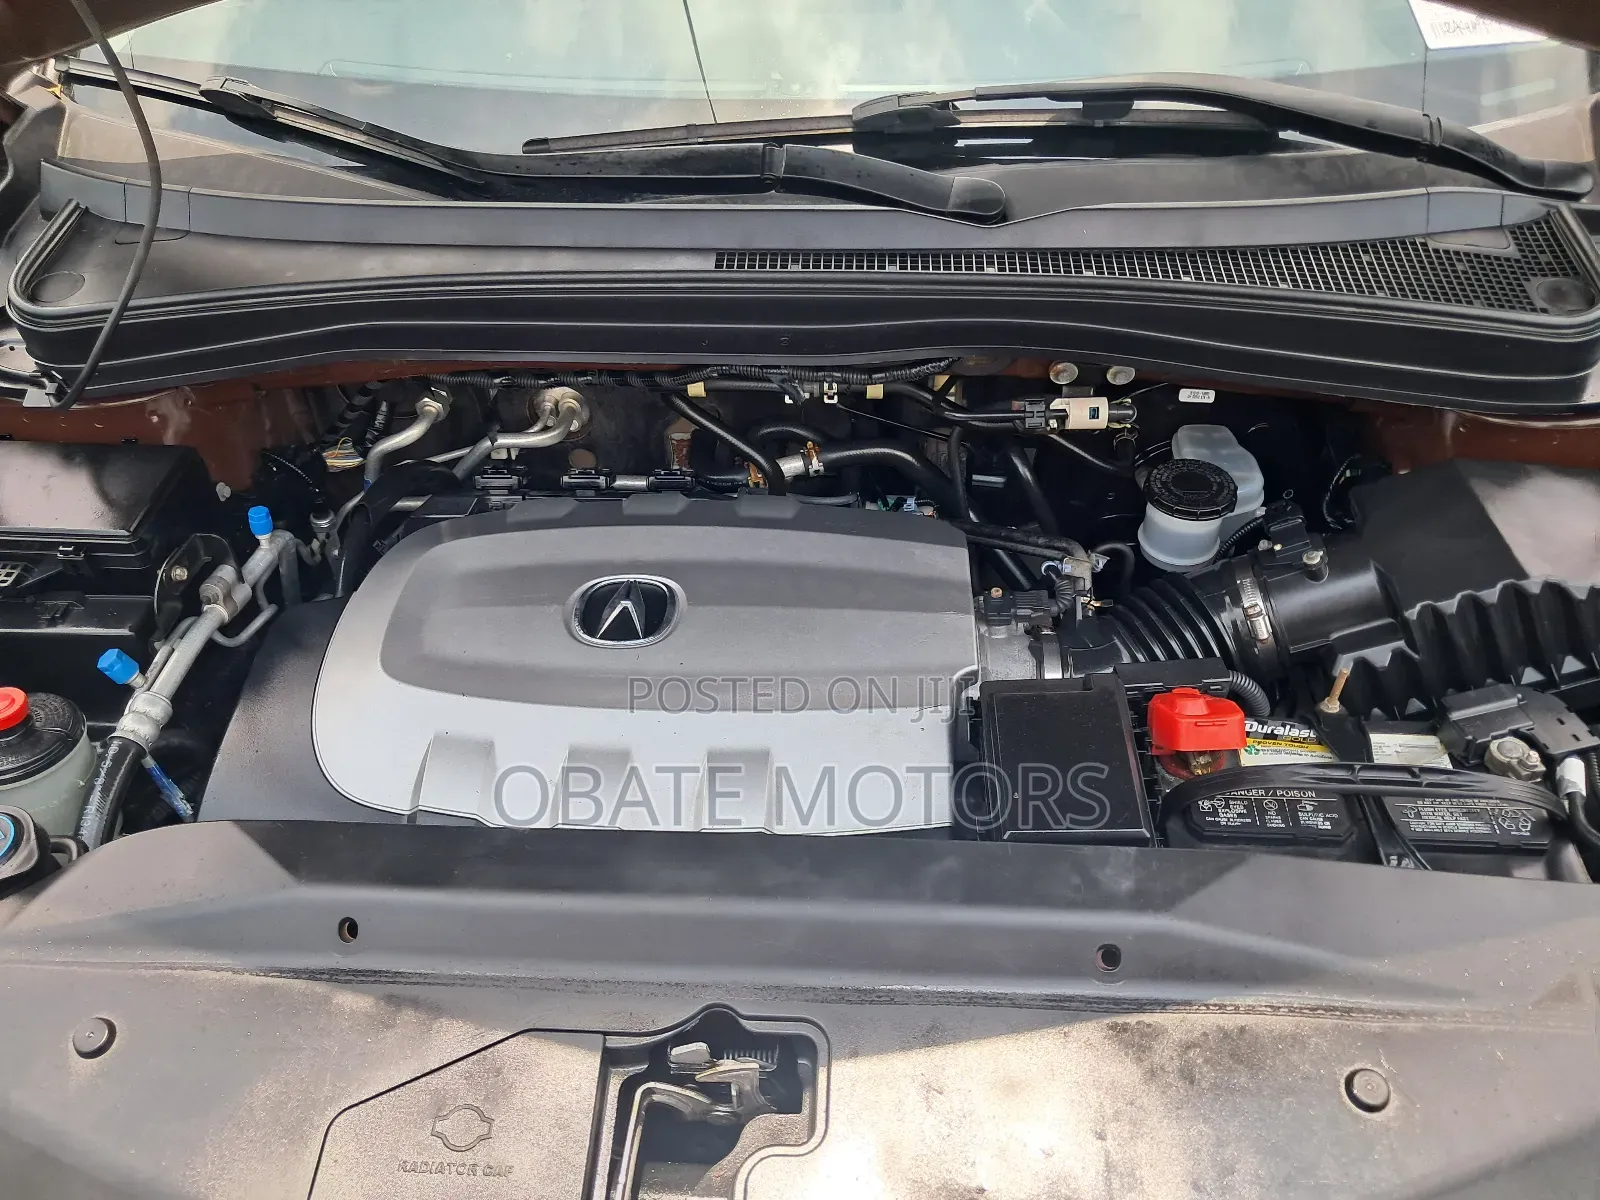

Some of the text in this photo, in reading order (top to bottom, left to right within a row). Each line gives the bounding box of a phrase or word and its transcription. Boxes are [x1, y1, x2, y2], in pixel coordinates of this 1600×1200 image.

[1225, 789, 1266, 797] ANGER
[1276, 790, 1316, 798] POISON
[397, 1159, 480, 1176] RADIATOR
